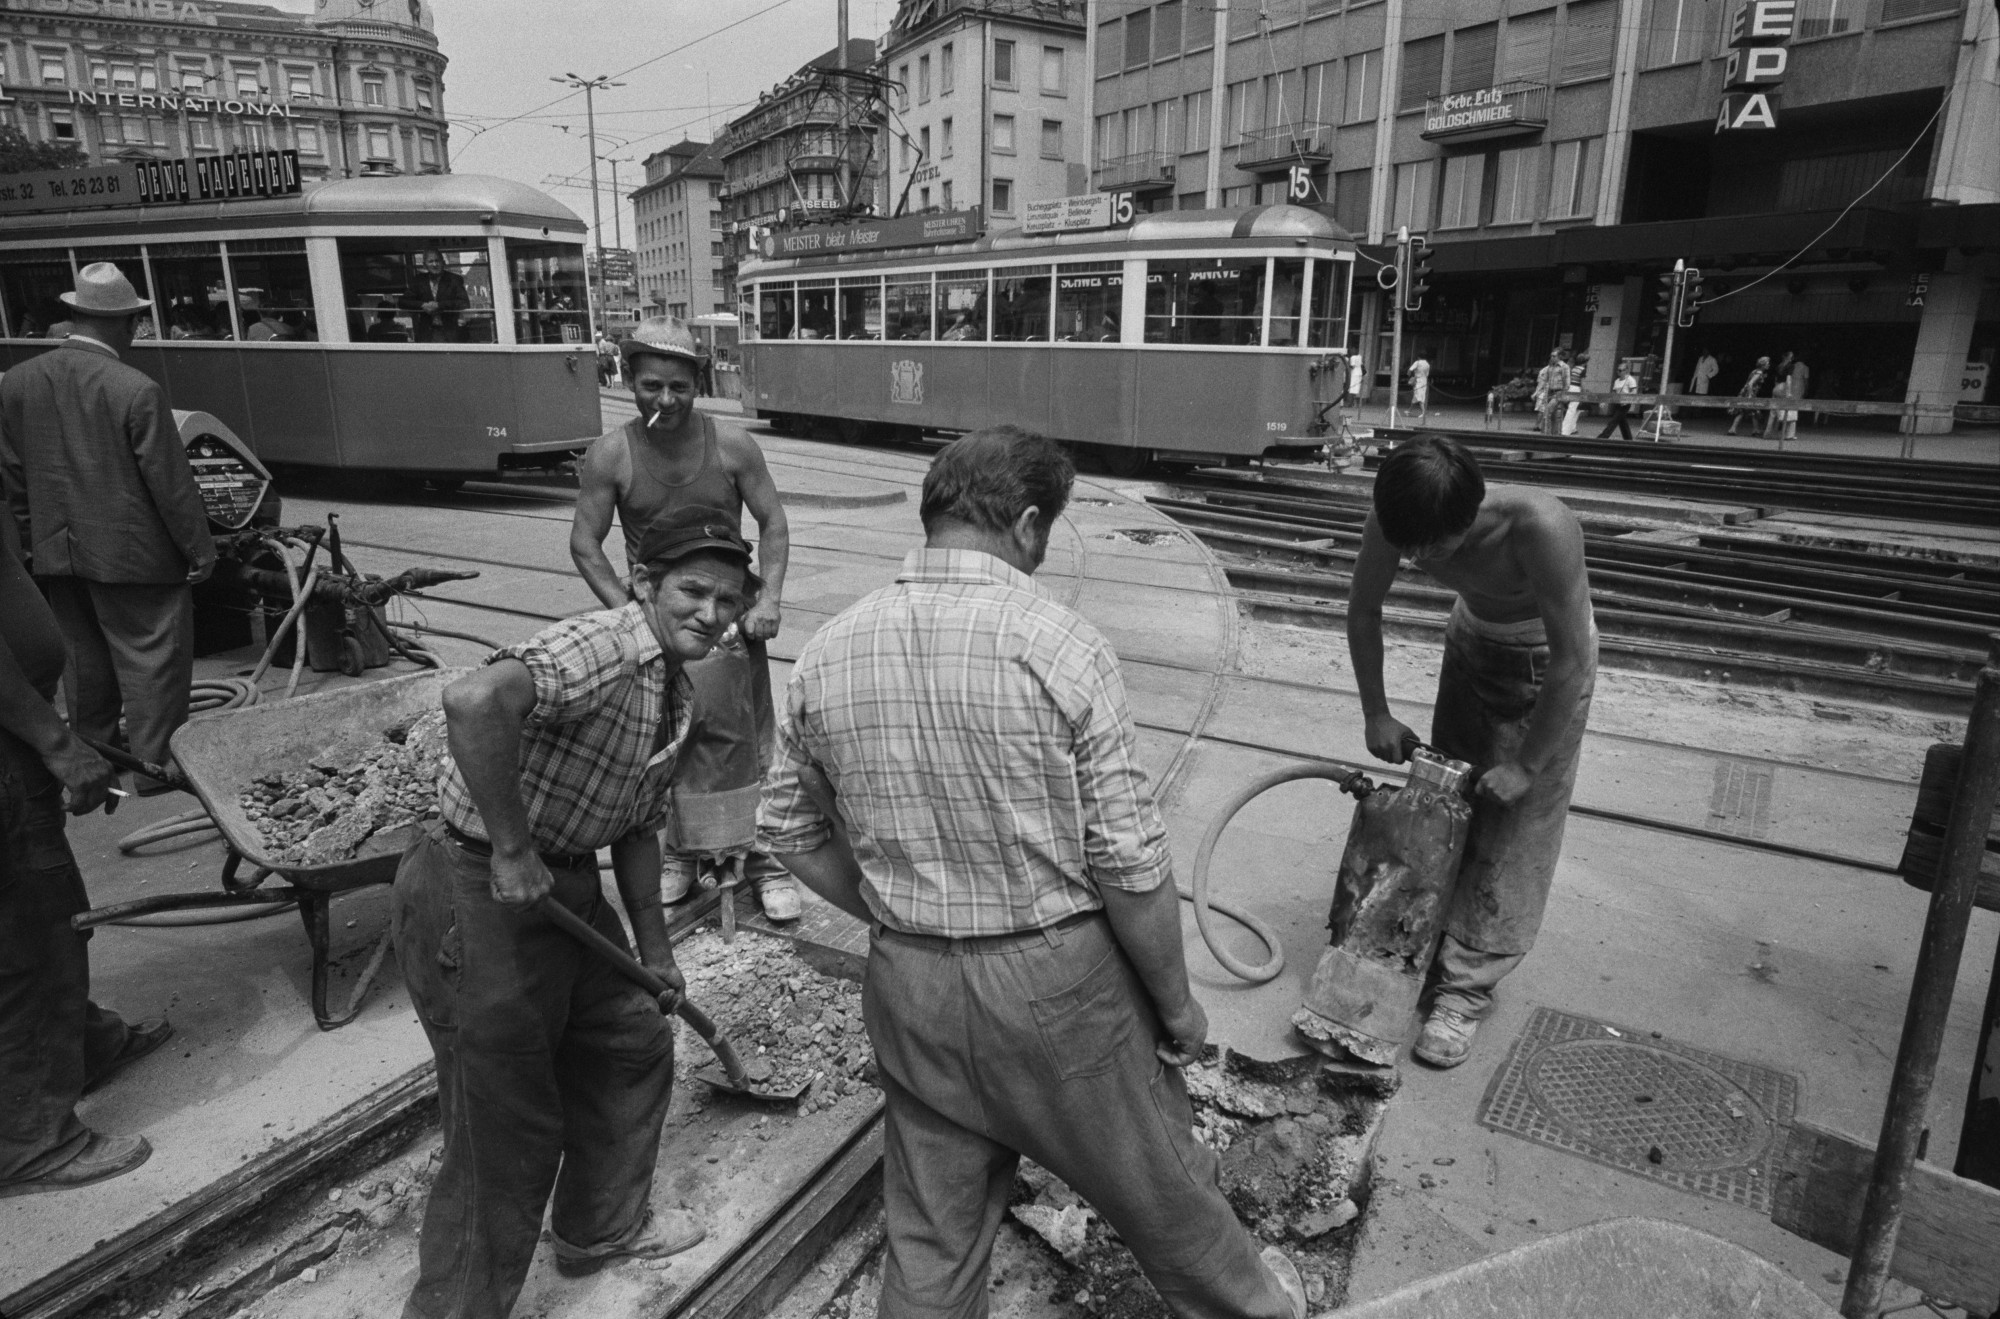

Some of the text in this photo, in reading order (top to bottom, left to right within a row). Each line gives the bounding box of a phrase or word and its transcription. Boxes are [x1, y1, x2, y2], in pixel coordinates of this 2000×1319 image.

[1731, 1, 1795, 128] EPA
[69, 90, 300, 118] INTERNATIONAL
[1428, 104, 1513, 131] GOLDSCHMIEDE
[138, 154, 296, 196] BENZ TAPETEN
[911, 165, 941, 184] OTEL
[1289, 165, 1310, 199] 15
[0, 175, 121, 201] str. 32 Tel. 26 23 81
[1067, 208, 1092, 217] Bellevue
[1111, 192, 1133, 224] 15
[783, 234, 821, 252] MEISTER
[849, 229, 880, 246] Meister
[567, 326, 578, 339] 11
[486, 426, 507, 437] 734
[1266, 421, 1287, 431] 1519
